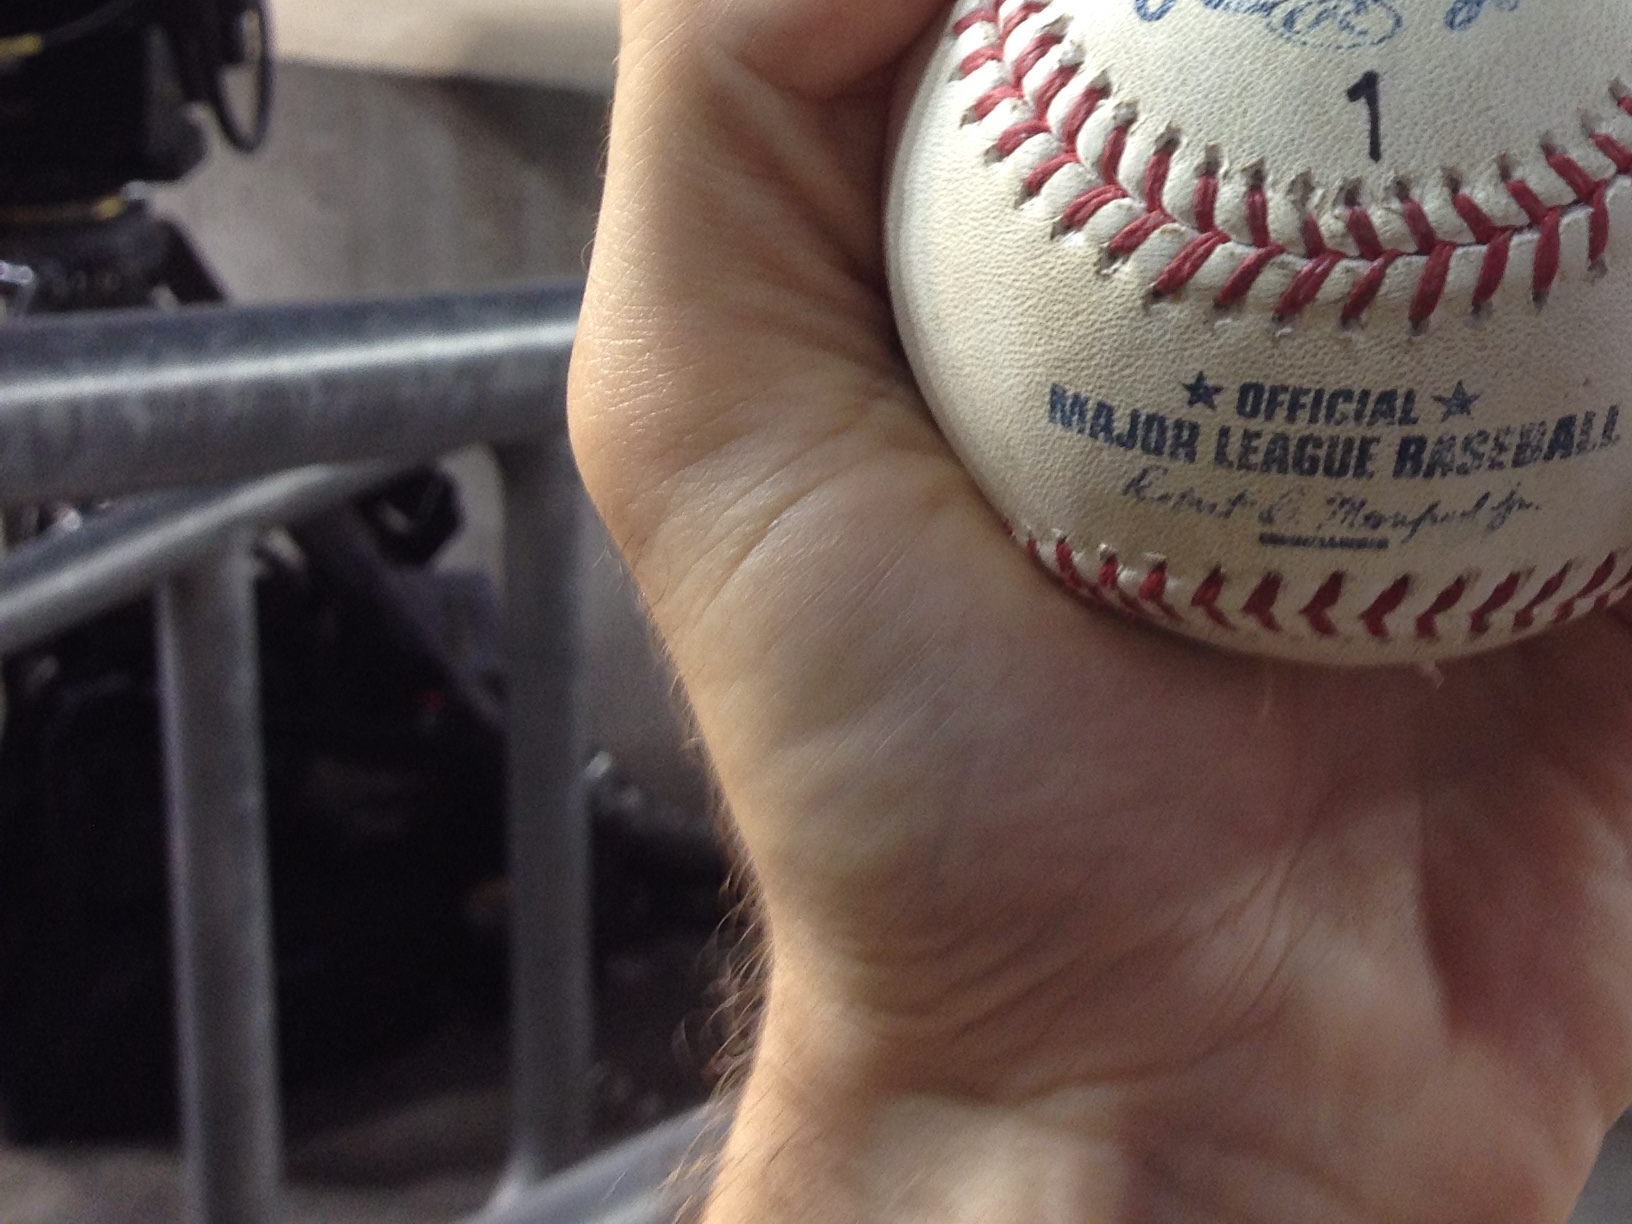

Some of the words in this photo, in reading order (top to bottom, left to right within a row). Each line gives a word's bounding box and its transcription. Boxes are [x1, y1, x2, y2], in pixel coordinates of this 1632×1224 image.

[1345, 70, 1382, 163] 1
[1048, 382, 1201, 464] MAJOR
[1213, 425, 1381, 480] LEAGUE
[1391, 403, 1620, 480] BASEBALL
[1236, 380, 1420, 426] OFFICIAL
